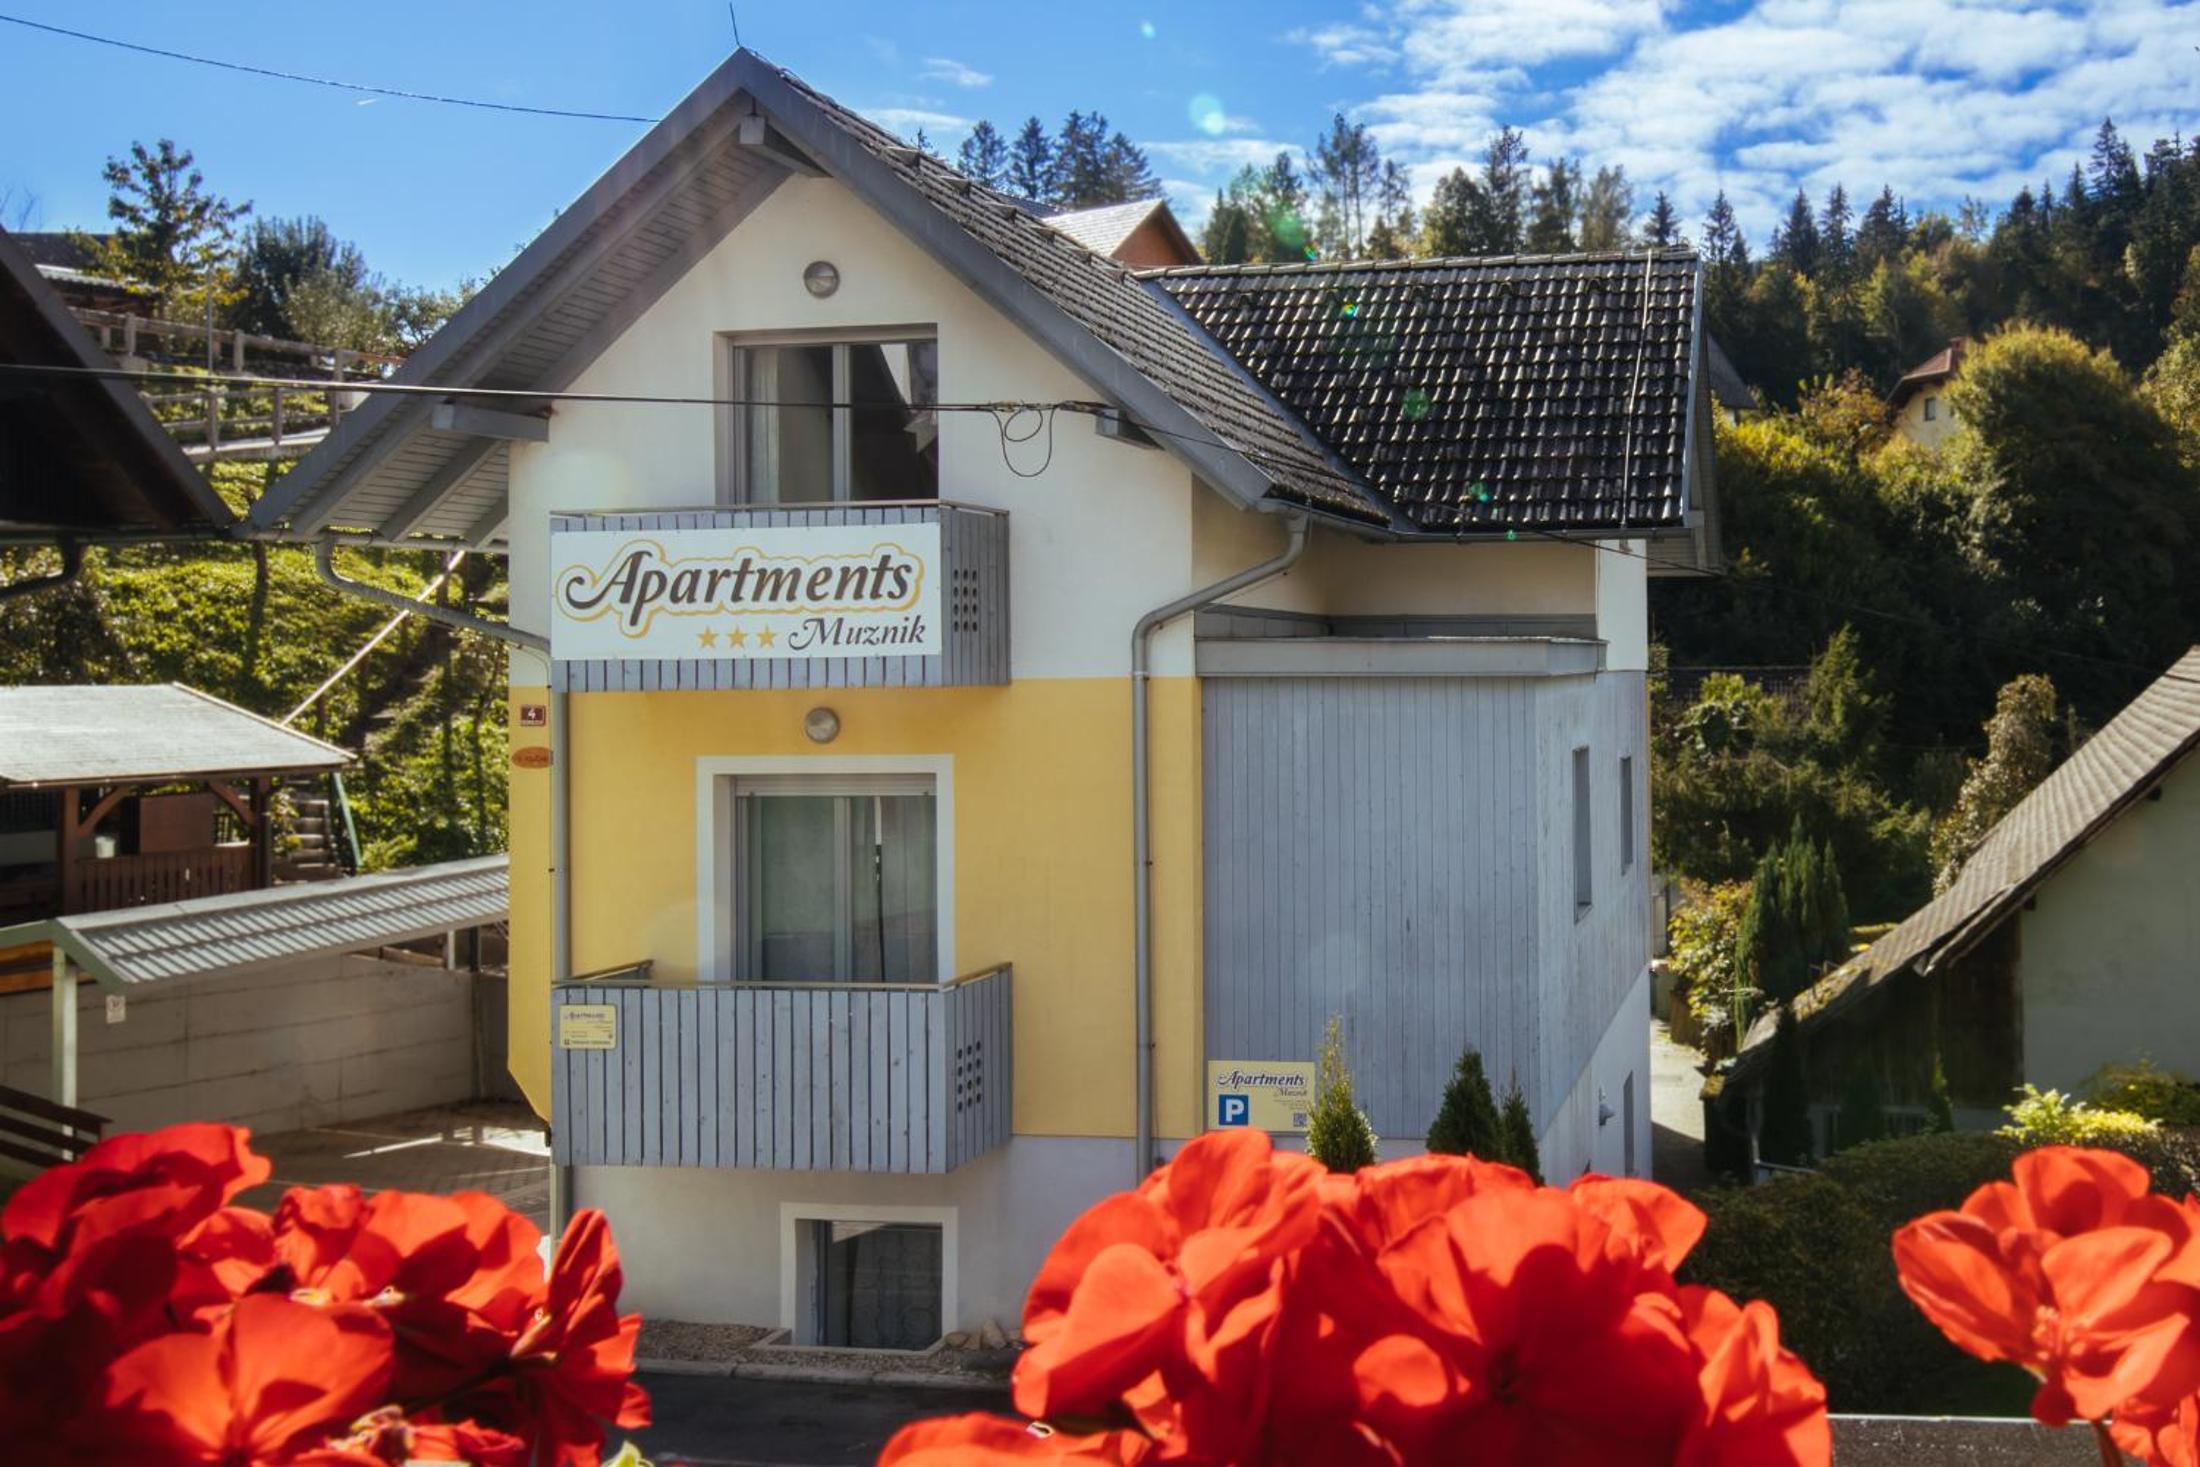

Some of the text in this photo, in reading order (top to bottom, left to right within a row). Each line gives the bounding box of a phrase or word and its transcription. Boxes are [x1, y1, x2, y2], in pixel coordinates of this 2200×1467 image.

[566, 550, 912, 626] Apartments
[787, 615, 926, 651] Muznik
[528, 707, 537, 720] 4
[1218, 1070, 1304, 1089] Apartments
[1225, 1098, 1245, 1123] P
